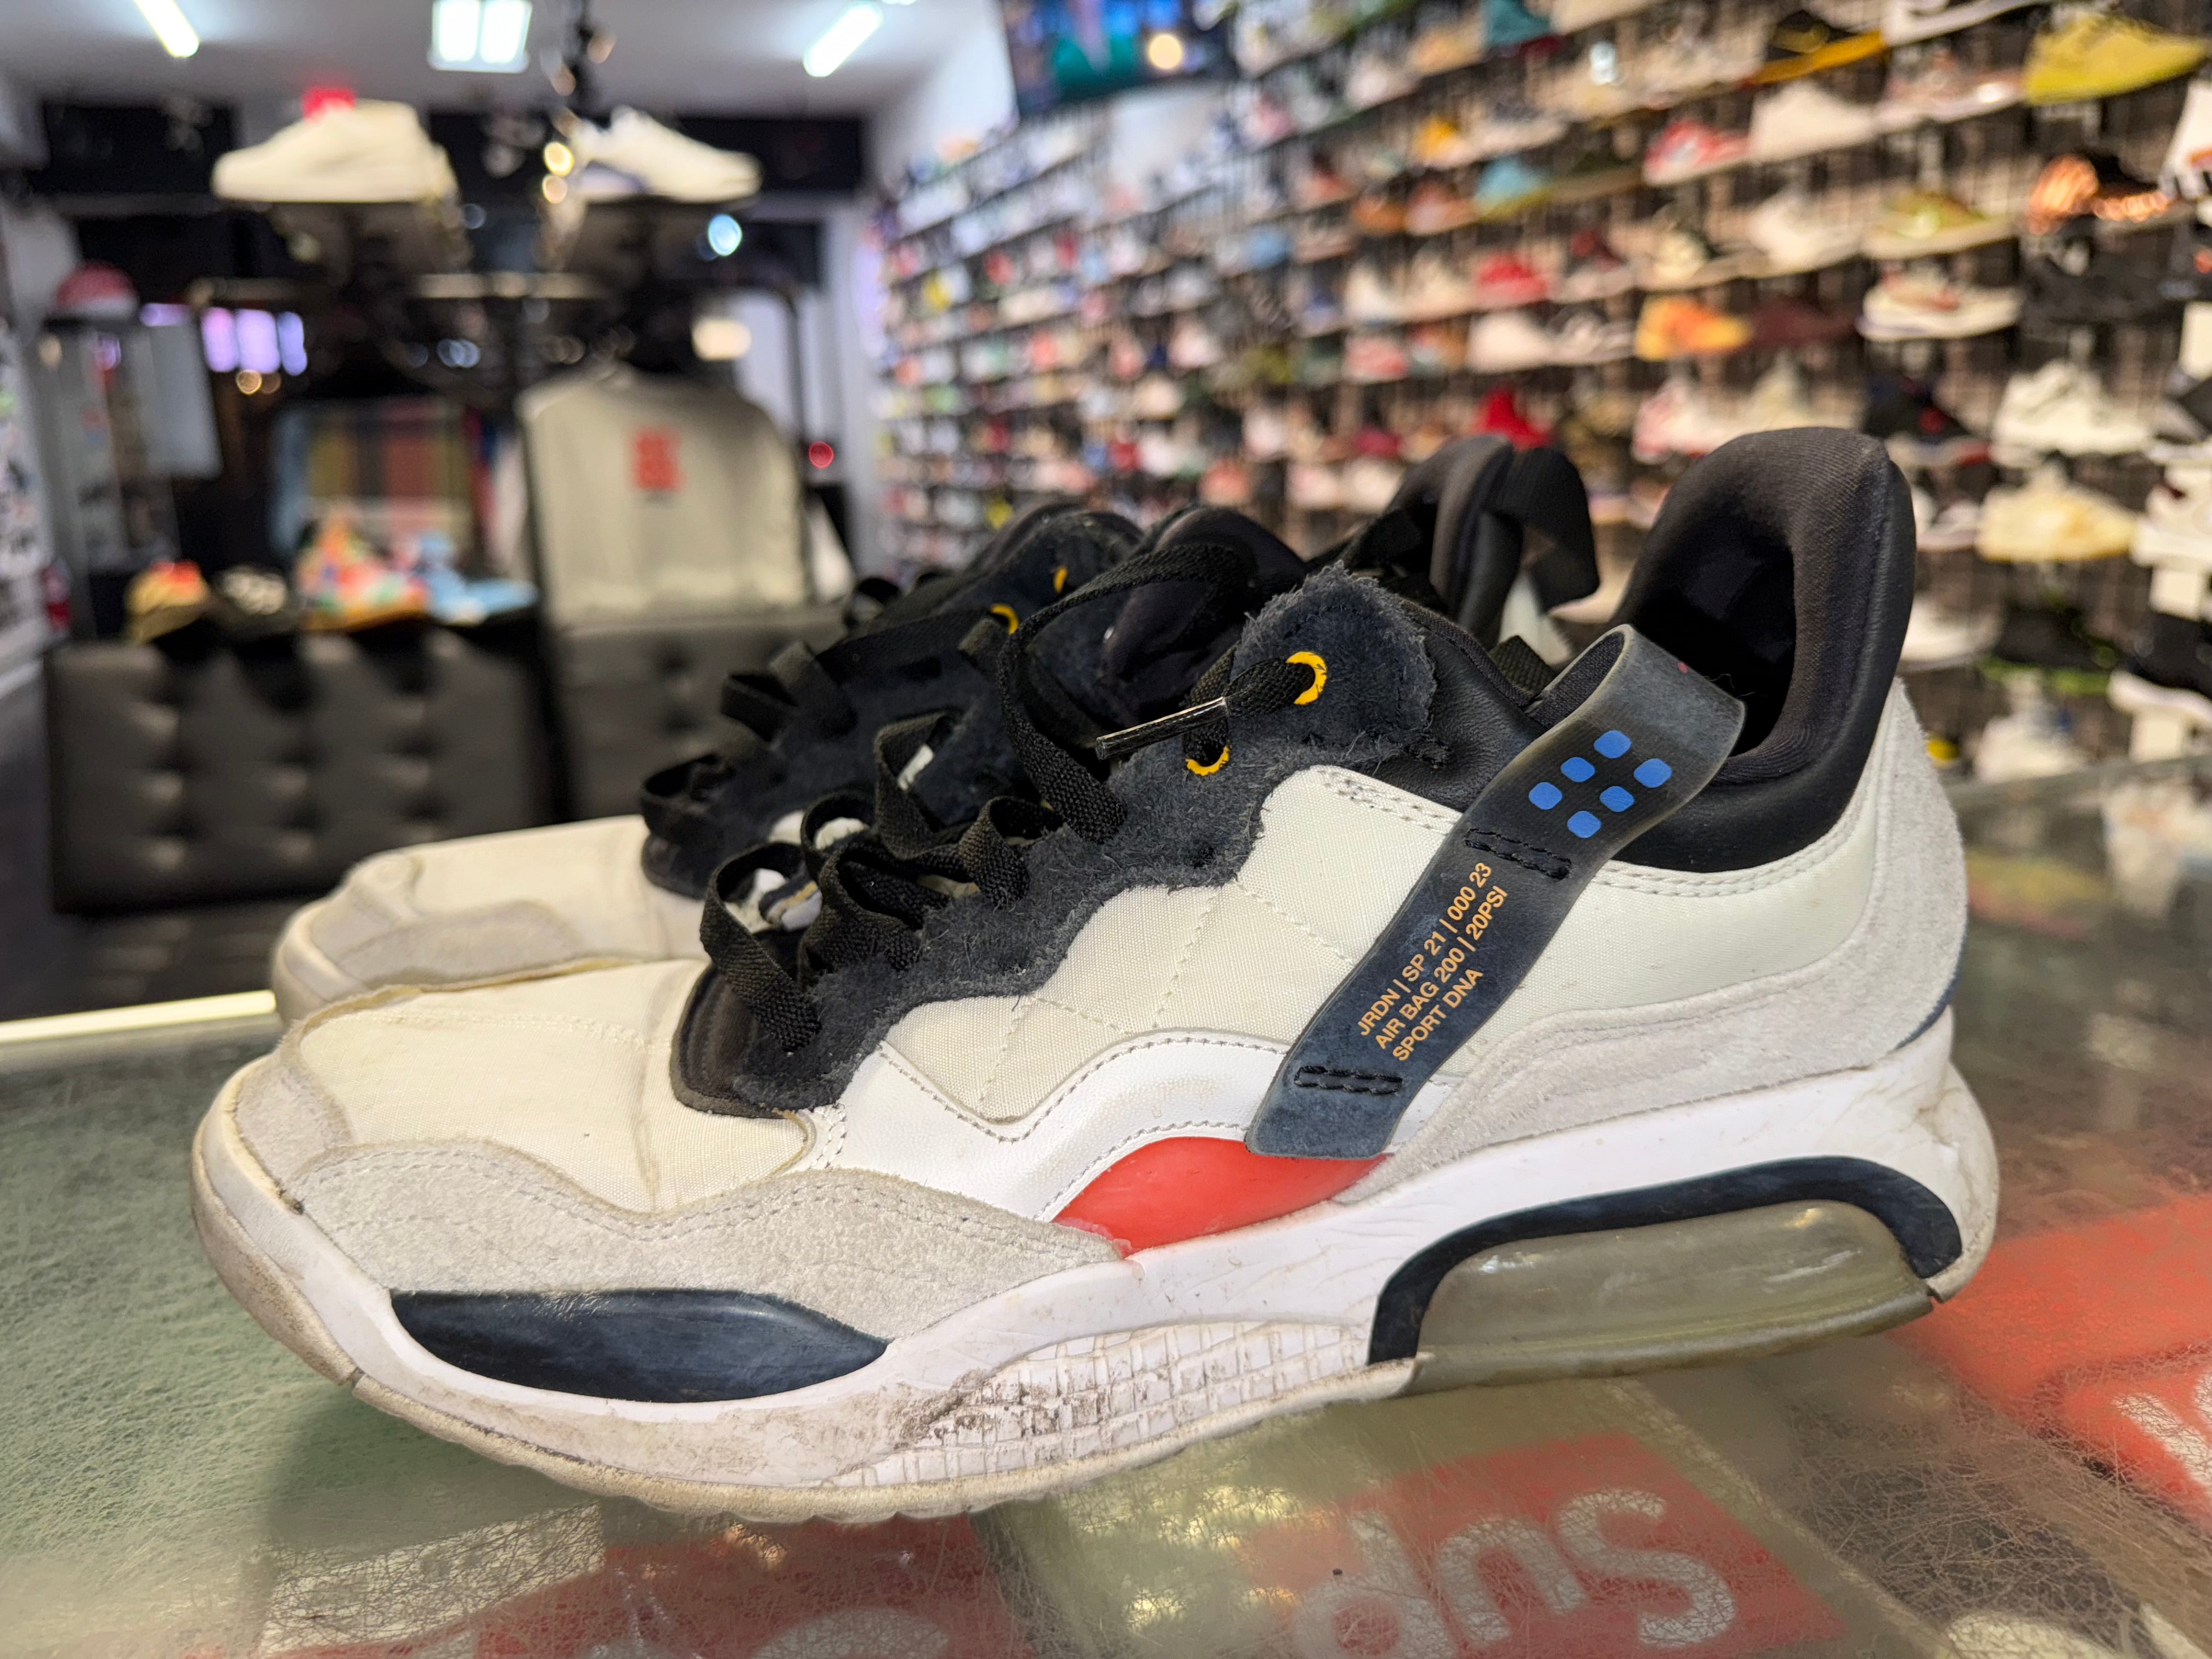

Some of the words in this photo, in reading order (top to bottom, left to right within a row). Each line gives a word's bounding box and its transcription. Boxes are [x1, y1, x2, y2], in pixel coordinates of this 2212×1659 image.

[1357, 988, 1401, 1036] JRDN
[1402, 953, 1425, 982] SP
[1424, 931, 1447, 956] 21
[1447, 886, 1476, 921] 000
[1469, 862, 1492, 888] 23
[1375, 1018, 1406, 1049] AIR
[1400, 981, 1440, 1020] BAG
[1434, 948, 1465, 983] 200
[1466, 885, 1508, 940] 20PSI
[1392, 1005, 1447, 1061] SPORT
[1442, 969, 1483, 1008] DNA
